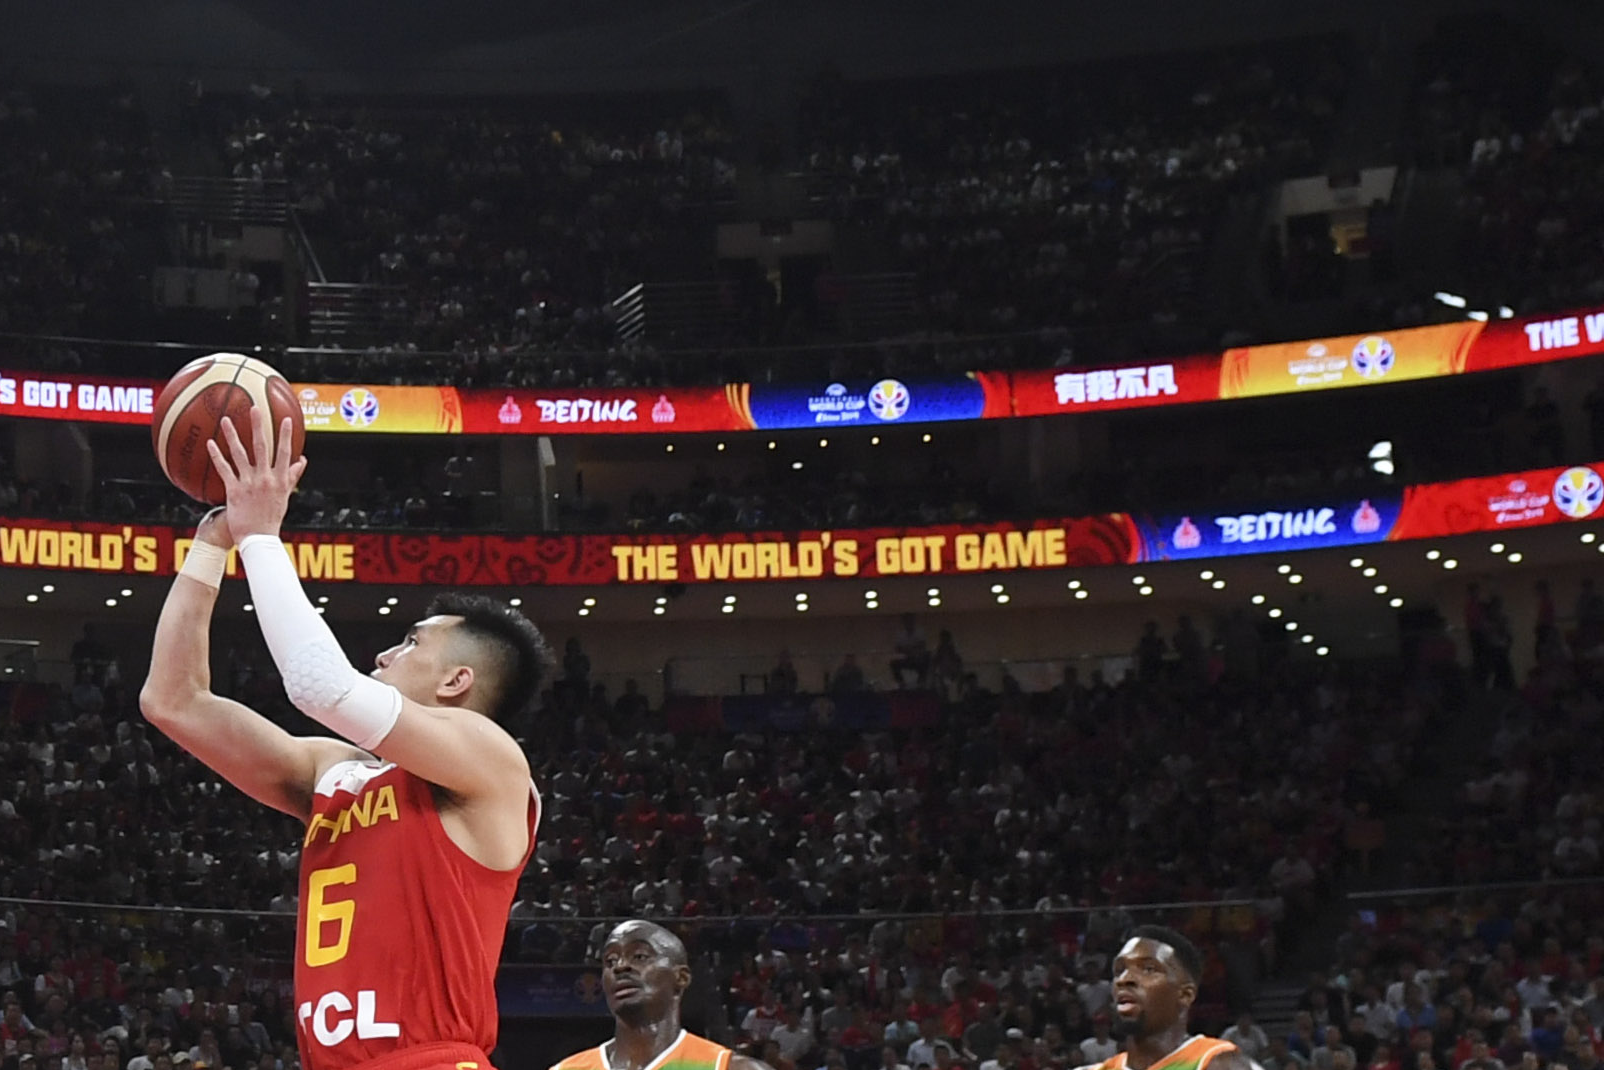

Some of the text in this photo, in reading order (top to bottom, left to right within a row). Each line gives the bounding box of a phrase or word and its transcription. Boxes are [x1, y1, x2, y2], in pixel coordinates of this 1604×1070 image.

[1524, 316, 1579, 352] THE
[23, 380, 71, 409] GOT
[78, 384, 153, 414] GAME
[1055, 364, 1178, 404] 有我不凡
[0, 527, 157, 572] WORLD'S
[286, 543, 354, 580] ME
[612, 529, 1067, 581] THE WORLD'S GOT GAME
[305, 863, 357, 967] 6
